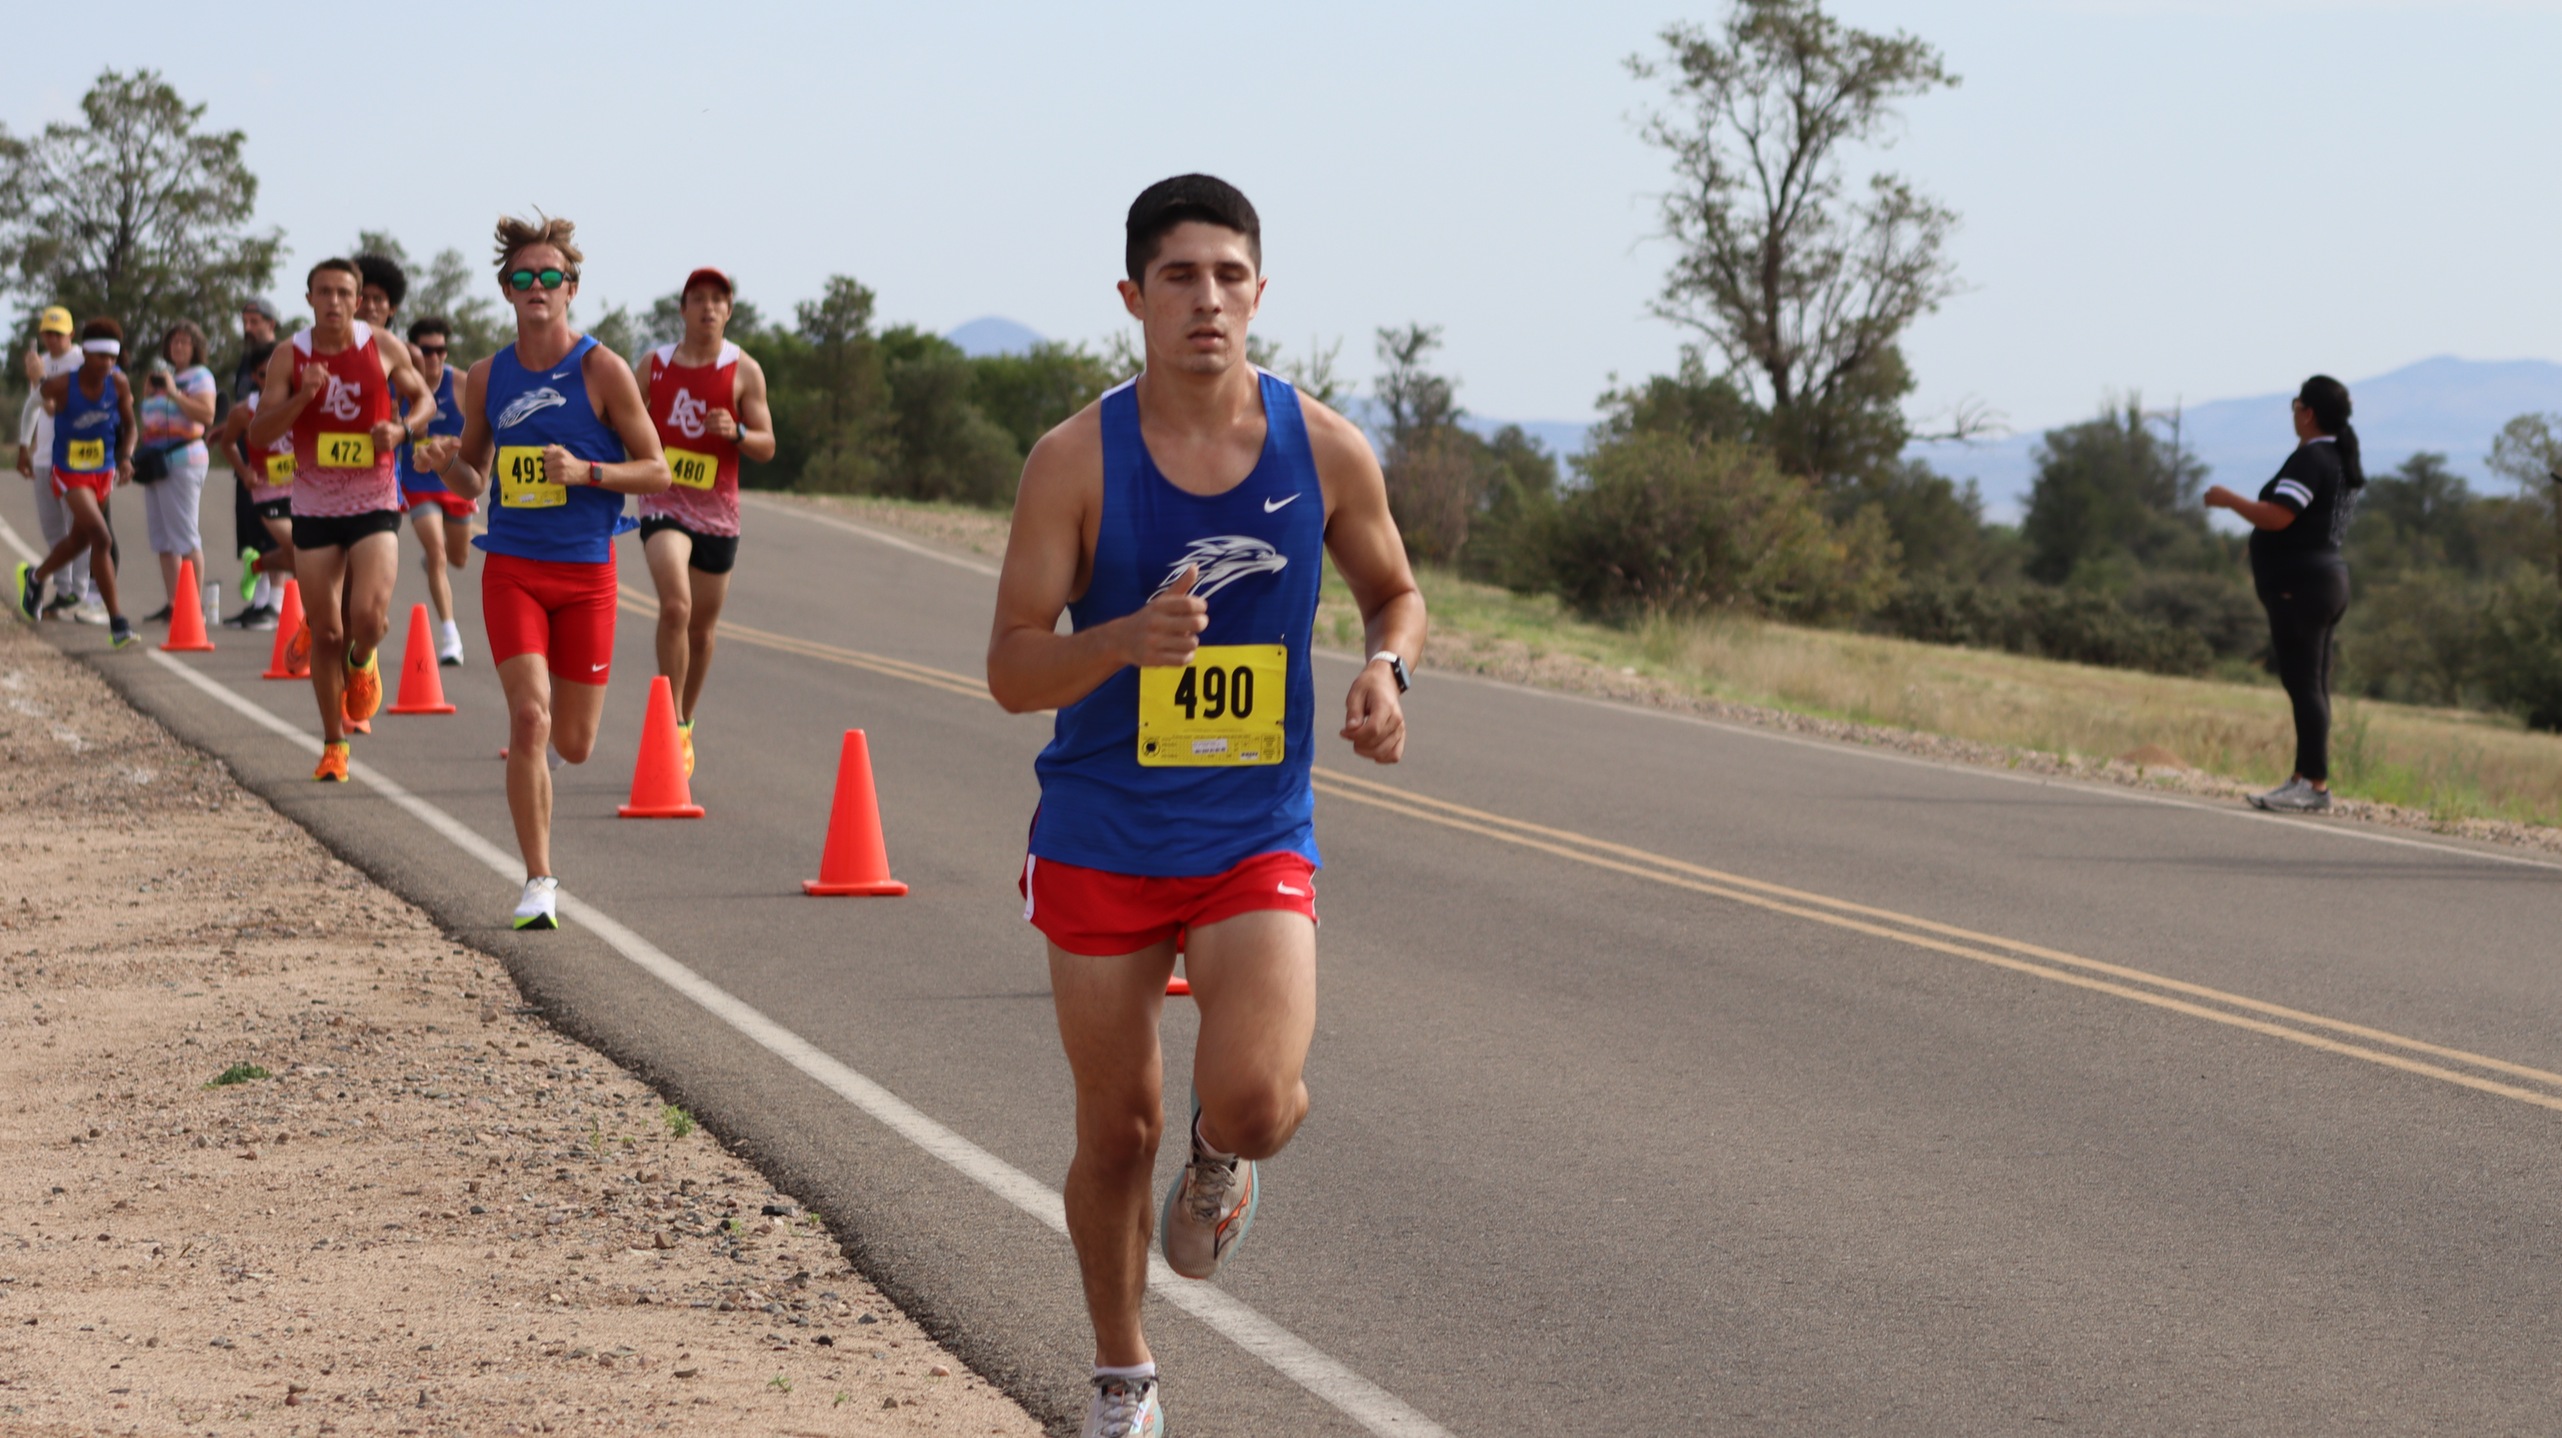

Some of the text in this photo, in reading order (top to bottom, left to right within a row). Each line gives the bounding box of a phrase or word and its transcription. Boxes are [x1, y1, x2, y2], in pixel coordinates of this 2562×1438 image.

[320, 375, 361, 421] AC
[667, 388, 706, 438] AC
[330, 440, 362, 463] 472
[511, 456, 548, 484] 493
[673, 457, 706, 483] 480
[1174, 665, 1254, 720] 490
